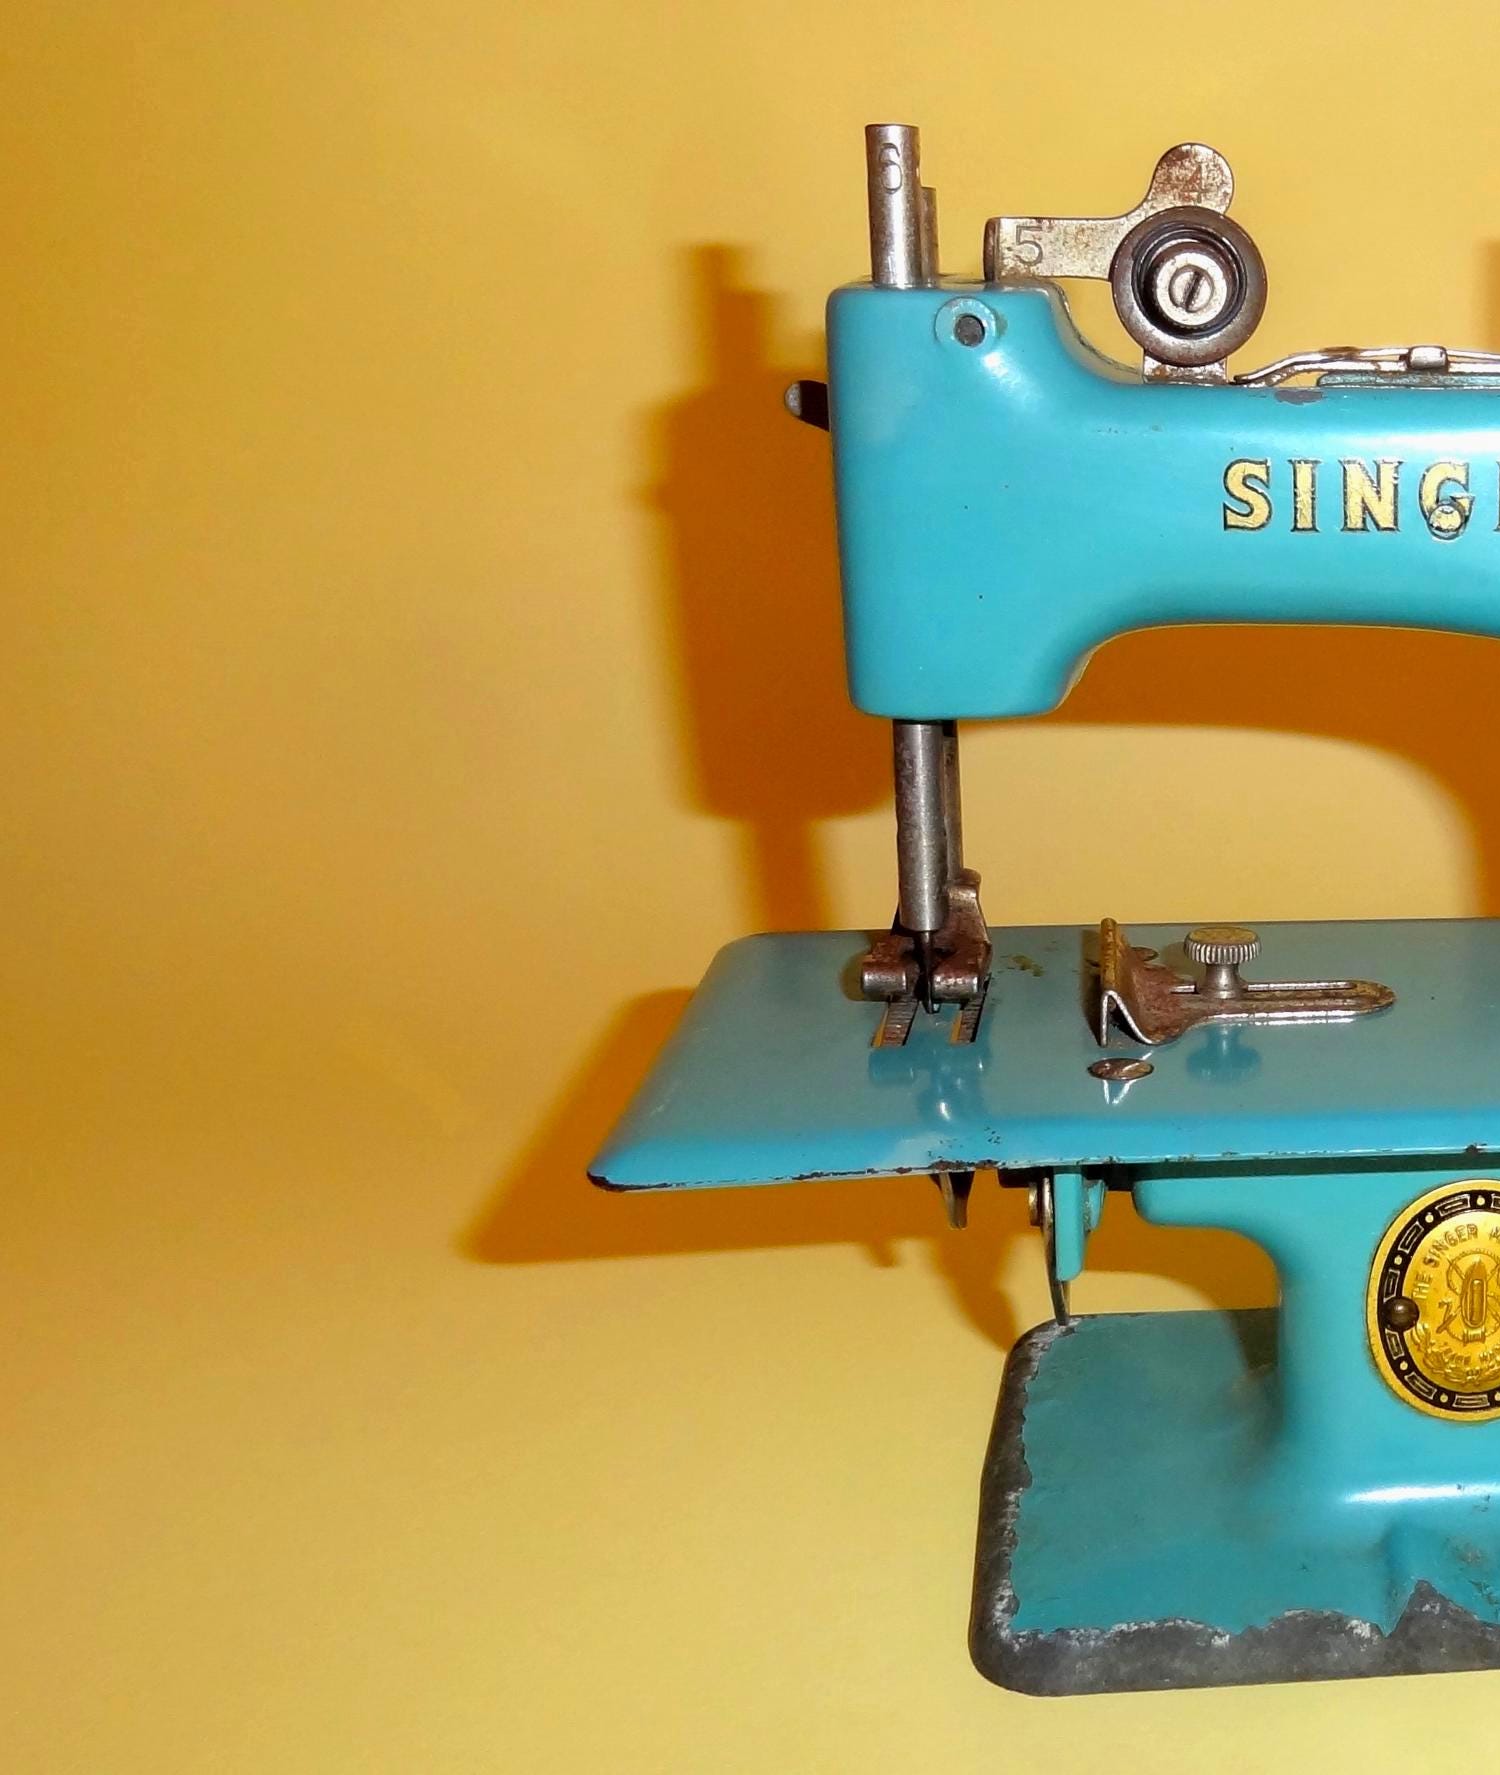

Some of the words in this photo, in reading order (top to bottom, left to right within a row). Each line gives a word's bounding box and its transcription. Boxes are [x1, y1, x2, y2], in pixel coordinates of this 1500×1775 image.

[878, 142, 903, 194] 6
[1013, 224, 1045, 267] 5
[1422, 1223, 1479, 1269] SINGER
[1411, 1271, 1434, 1299] THE
